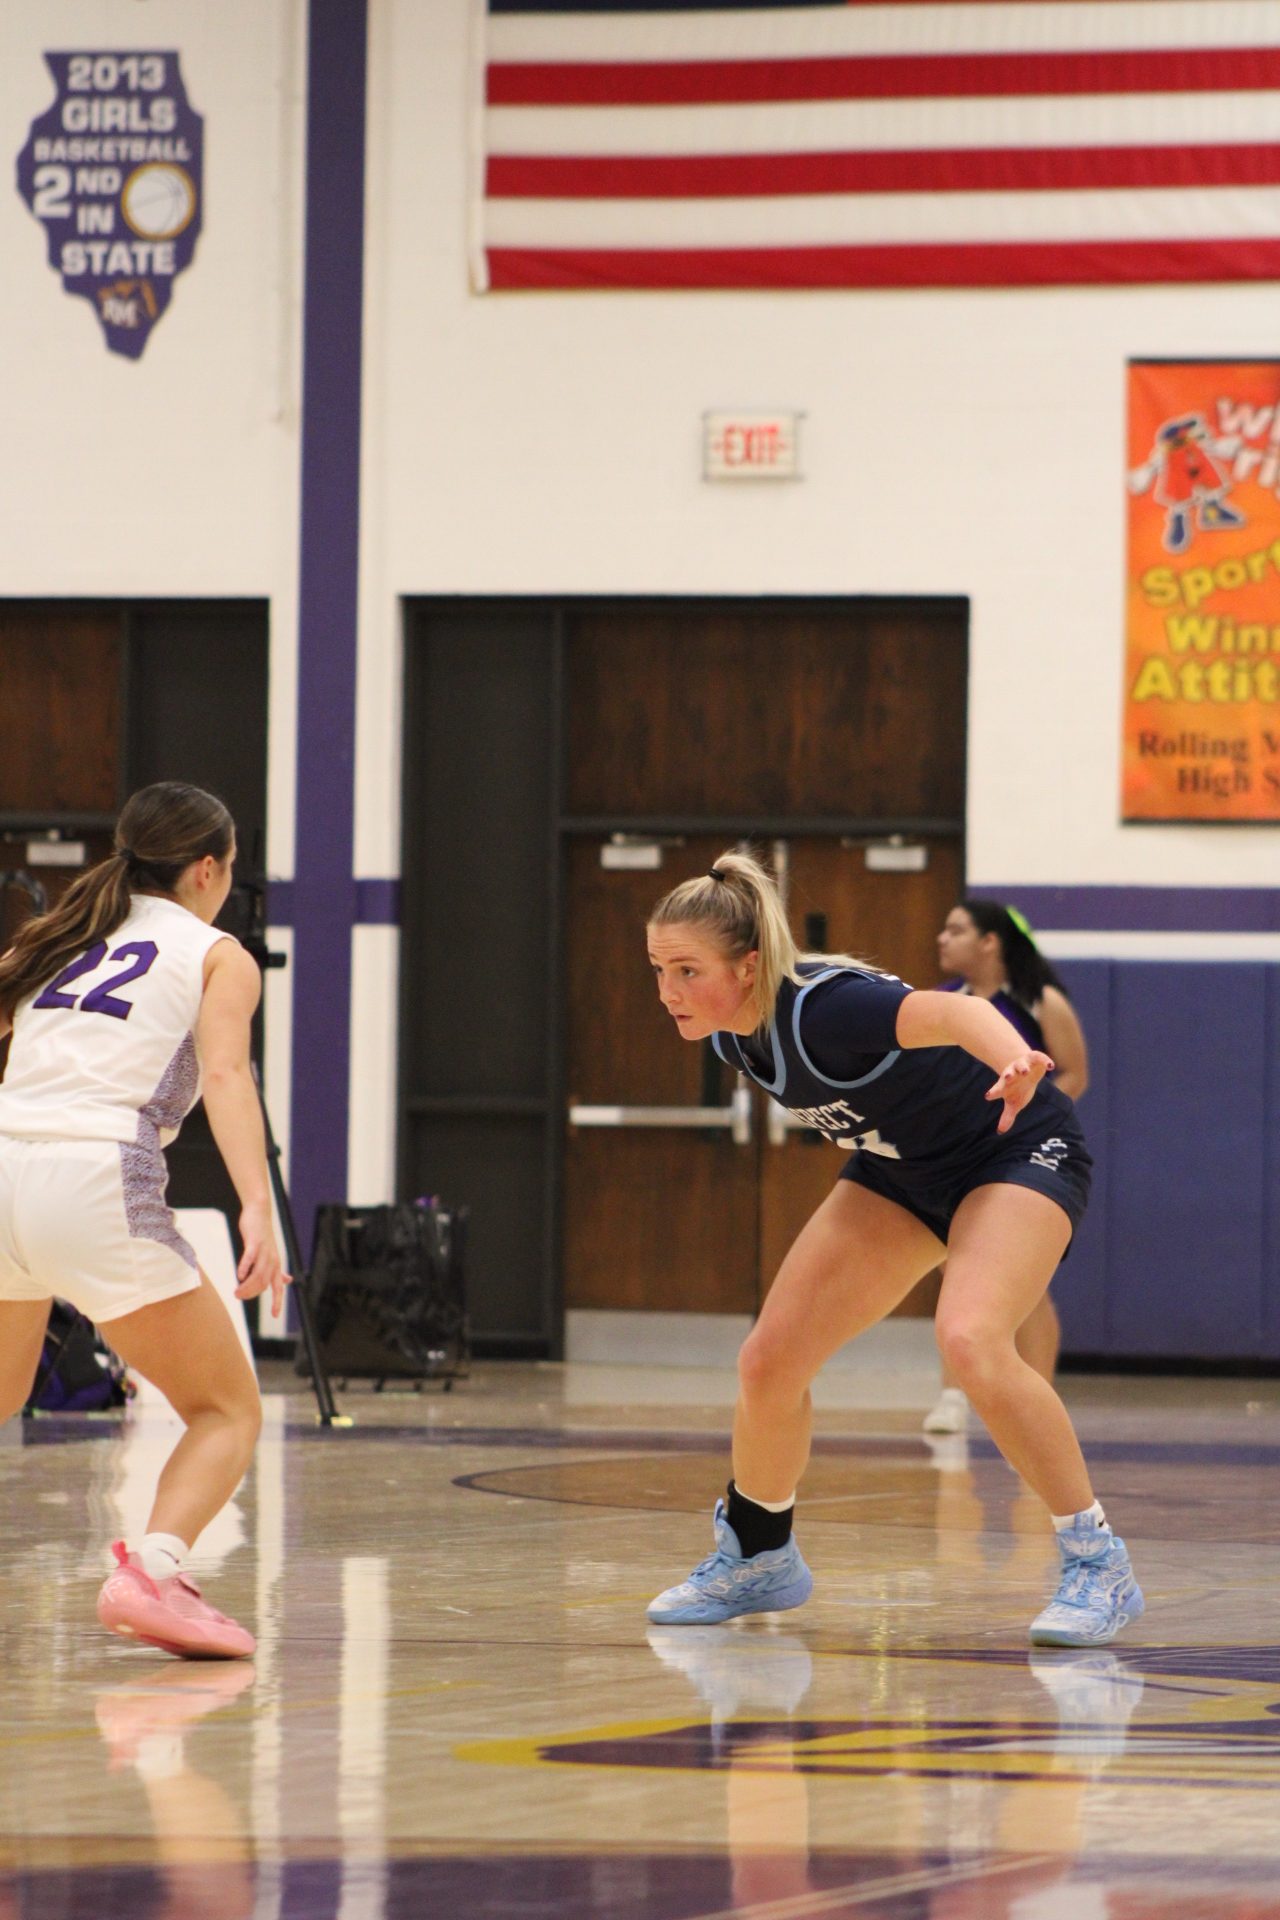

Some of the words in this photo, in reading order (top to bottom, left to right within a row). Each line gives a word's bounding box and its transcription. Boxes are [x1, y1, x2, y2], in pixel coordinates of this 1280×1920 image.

[67, 56, 166, 92] 2013
[61, 98, 177, 133] GIRLS
[33, 138, 191, 163] BASKETBALL
[76, 204, 115, 235] IN
[61, 241, 176, 276] STATE
[723, 423, 779, 467] EXIT
[1165, 614, 1280, 654] Win
[1138, 731, 1248, 762] Rolling
[1177, 766, 1250, 798] High
[32, 938, 159, 1021] 22
